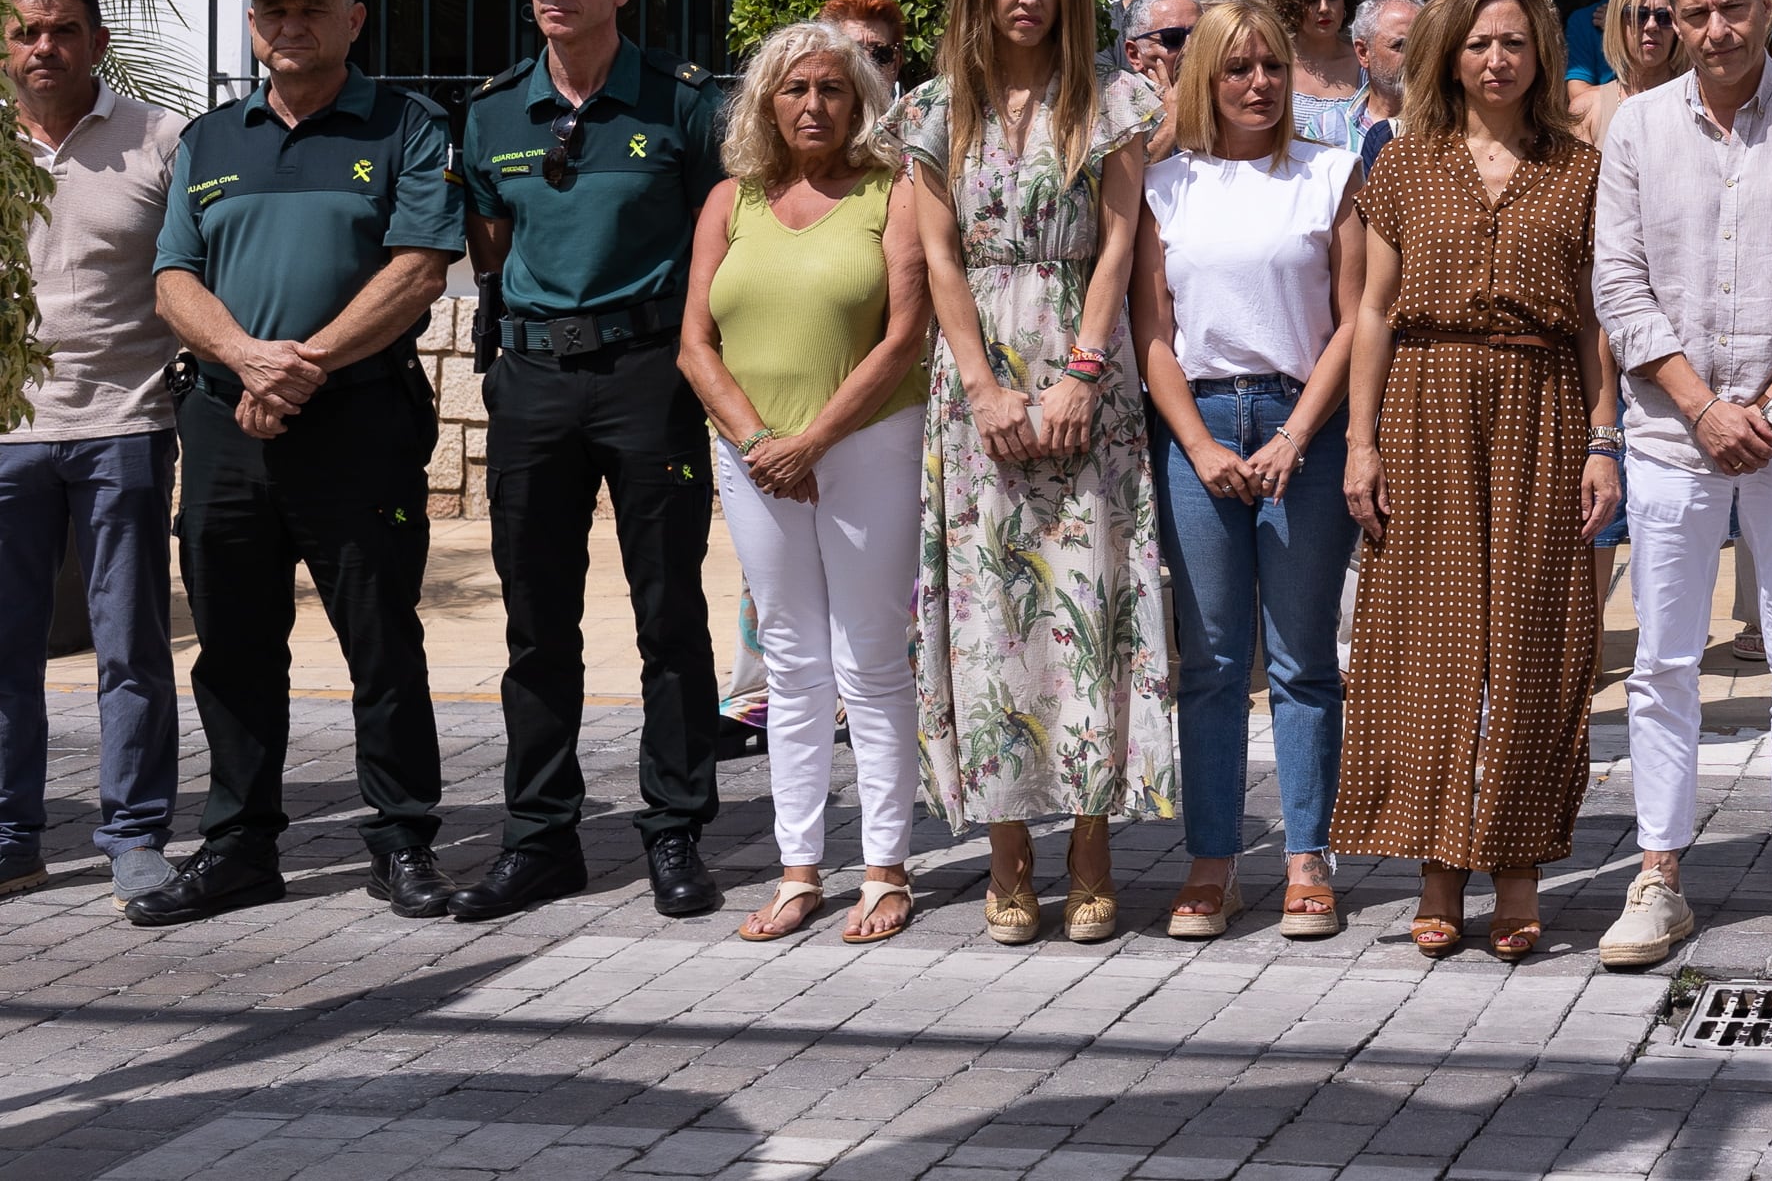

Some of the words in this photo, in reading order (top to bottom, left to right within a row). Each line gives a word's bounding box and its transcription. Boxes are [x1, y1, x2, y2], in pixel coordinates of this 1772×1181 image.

[492, 152, 524, 163] GUARDIA
[525, 148, 546, 158] CIVIL
[219, 174, 240, 184] CIVIL
